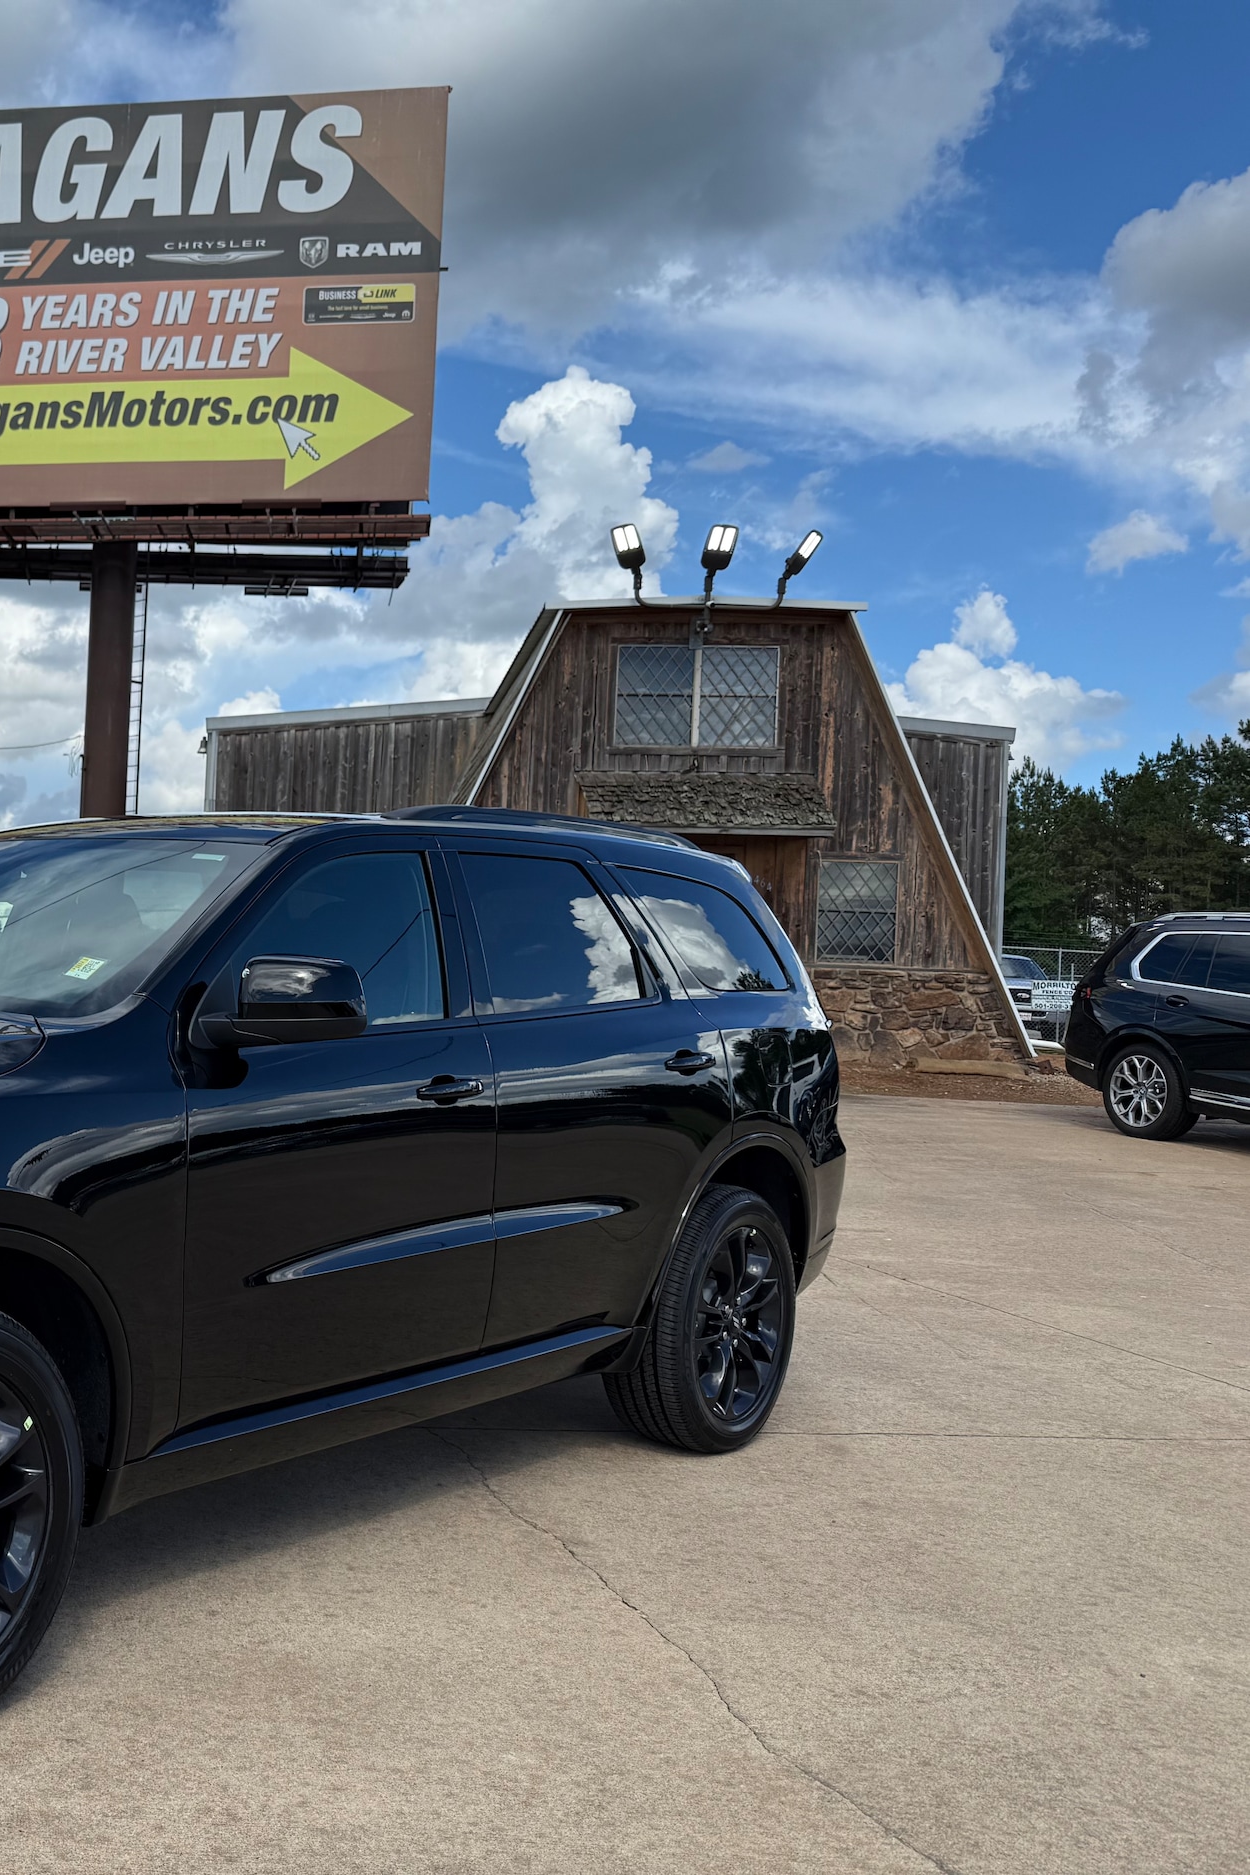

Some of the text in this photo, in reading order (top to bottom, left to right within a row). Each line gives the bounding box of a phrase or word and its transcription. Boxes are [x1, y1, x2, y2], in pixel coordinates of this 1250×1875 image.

[72, 242, 134, 268] Jeep
[164, 239, 267, 250] CHRYSLER
[337, 242, 422, 258] RAM
[318, 289, 397, 300] BUSINESS LINK
[21, 287, 280, 331] YEARS IN THE
[15, 333, 283, 376] RIVER VALLEY
